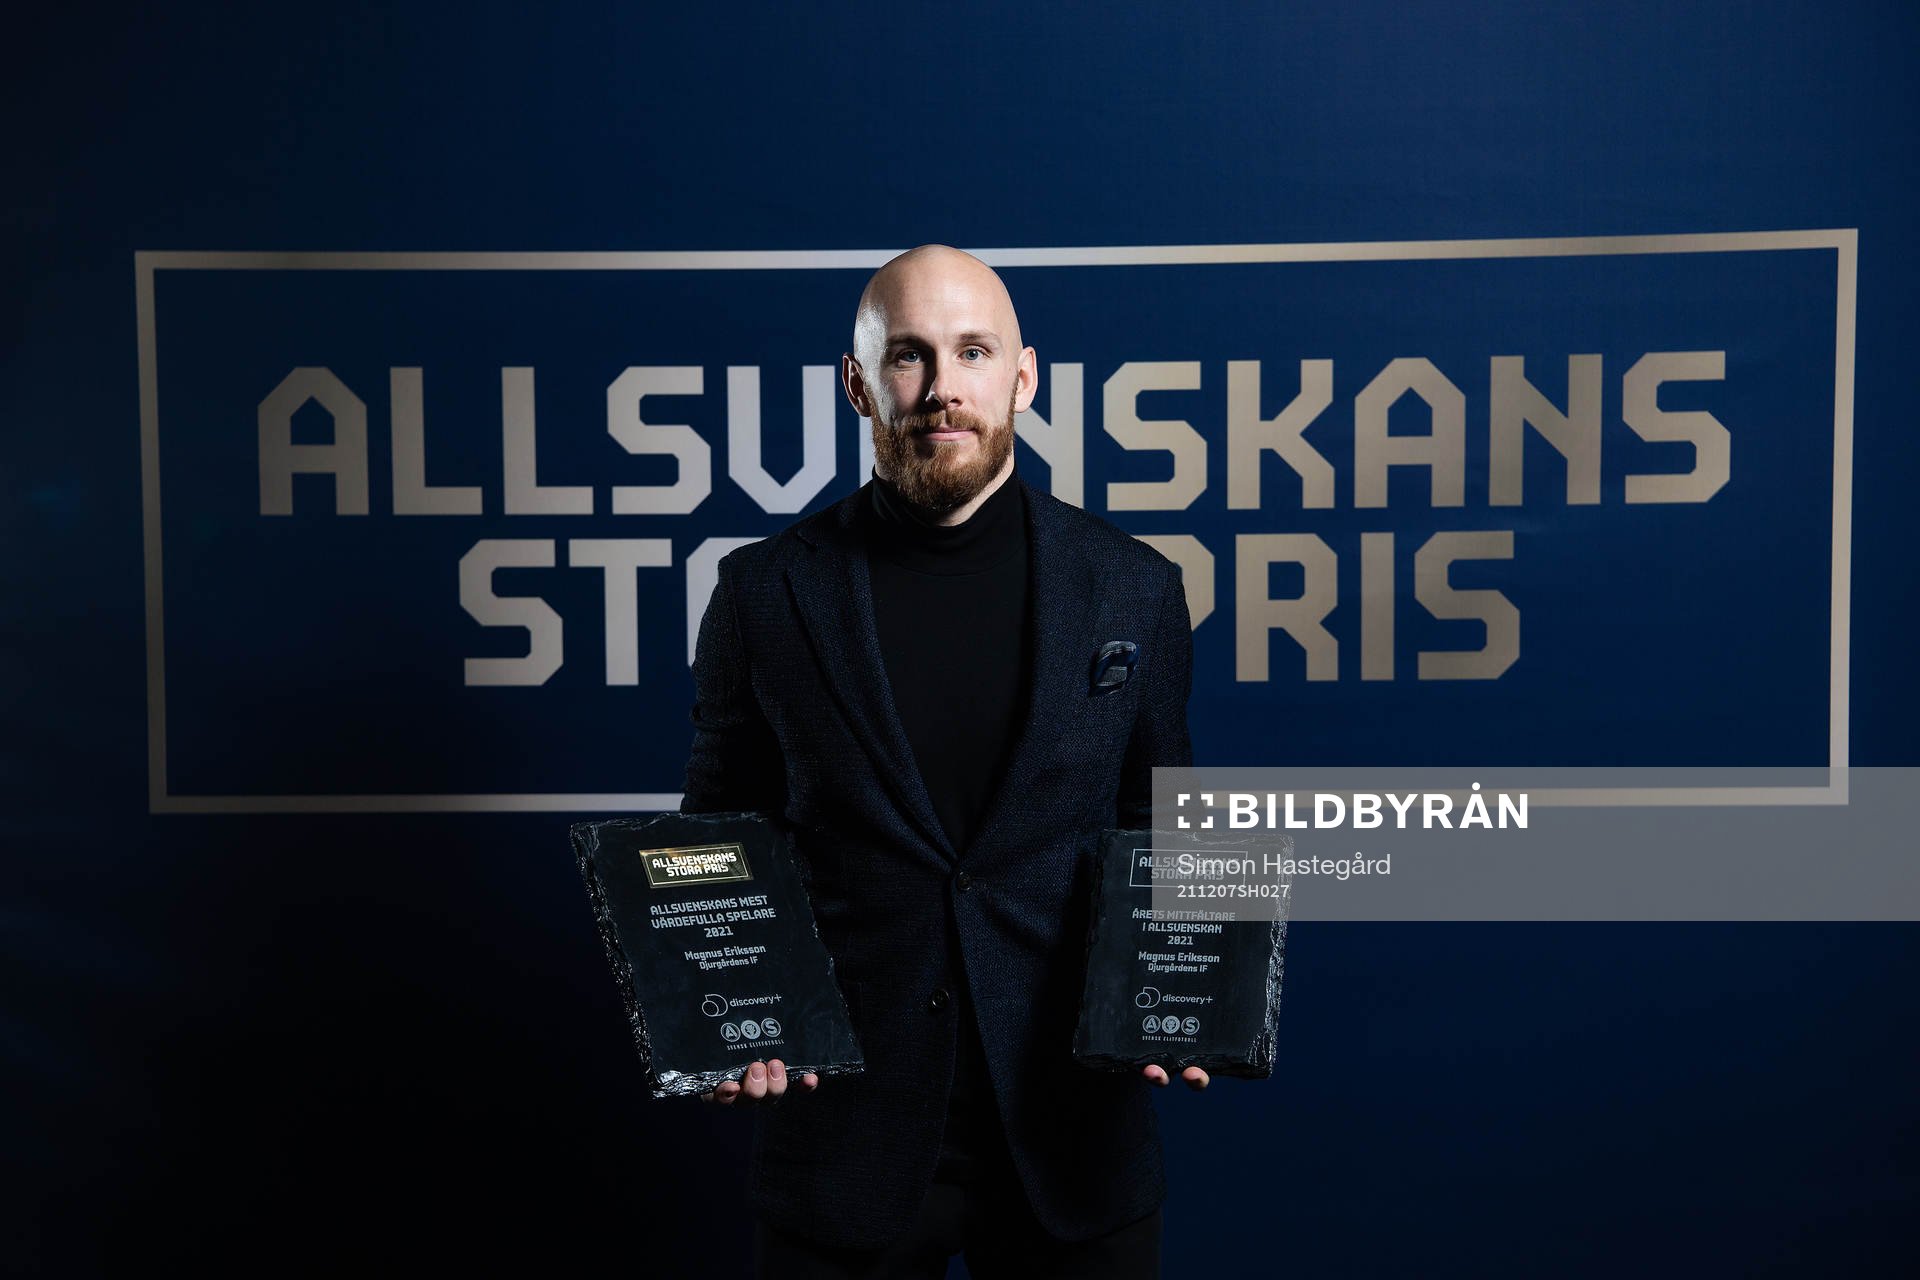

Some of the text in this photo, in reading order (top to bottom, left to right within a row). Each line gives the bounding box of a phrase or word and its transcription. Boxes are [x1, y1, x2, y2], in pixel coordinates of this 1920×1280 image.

[257, 350, 1731, 517] ALLSVNSKANS
[651, 852, 737, 869] ALLSVENSKANS
[666, 863, 729, 877] STORA PRIS
[650, 895, 768, 915] ALLSVENSKANS MEST
[651, 907, 776, 929] VÄRDEFULLA SPELARE
[1132, 908, 1236, 921] ÅRETS MITTFÄLTARE
[704, 926, 734, 938] 2021
[1148, 922, 1222, 933] ALLSVENSKAN
[1167, 935, 1194, 945] 2021
[684, 945, 767, 961] Magnus Eriksson
[1138, 951, 1220, 963] Magnus Eriksson
[699, 956, 758, 971] Djurgårdens IF
[1148, 963, 1208, 973] Djurgårdens IF
[729, 993, 782, 1007] discovery+
[1162, 994, 1214, 1004] discovery+
